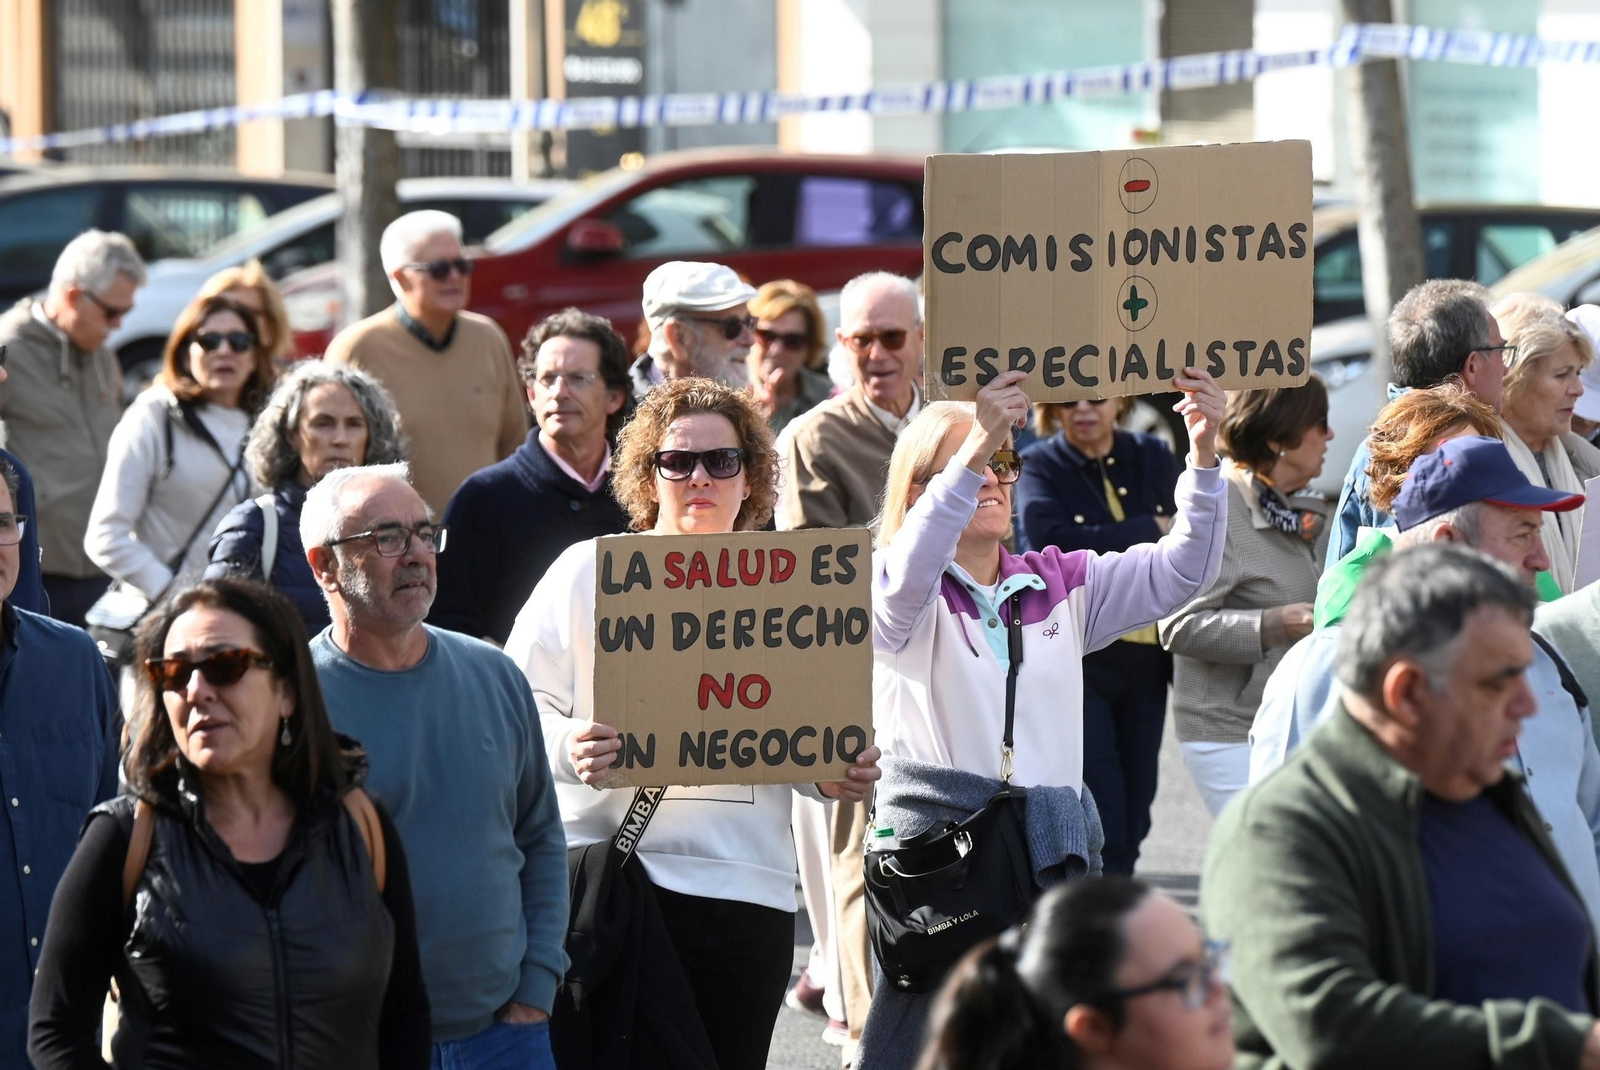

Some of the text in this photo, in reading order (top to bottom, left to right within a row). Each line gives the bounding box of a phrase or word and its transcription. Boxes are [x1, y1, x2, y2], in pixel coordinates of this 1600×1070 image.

[932, 222, 1307, 273] COMISIONISTAS
[941, 338, 1306, 388] ESPECIALISTAS
[601, 543, 859, 595] LA SALUD ES
[600, 605, 870, 653] UN DERECHO
[698, 672, 772, 711] NO
[679, 725, 867, 770] NEGOCIO
[616, 787, 662, 854] BIMBA
[927, 909, 979, 936] BIMBA Y LOLA
